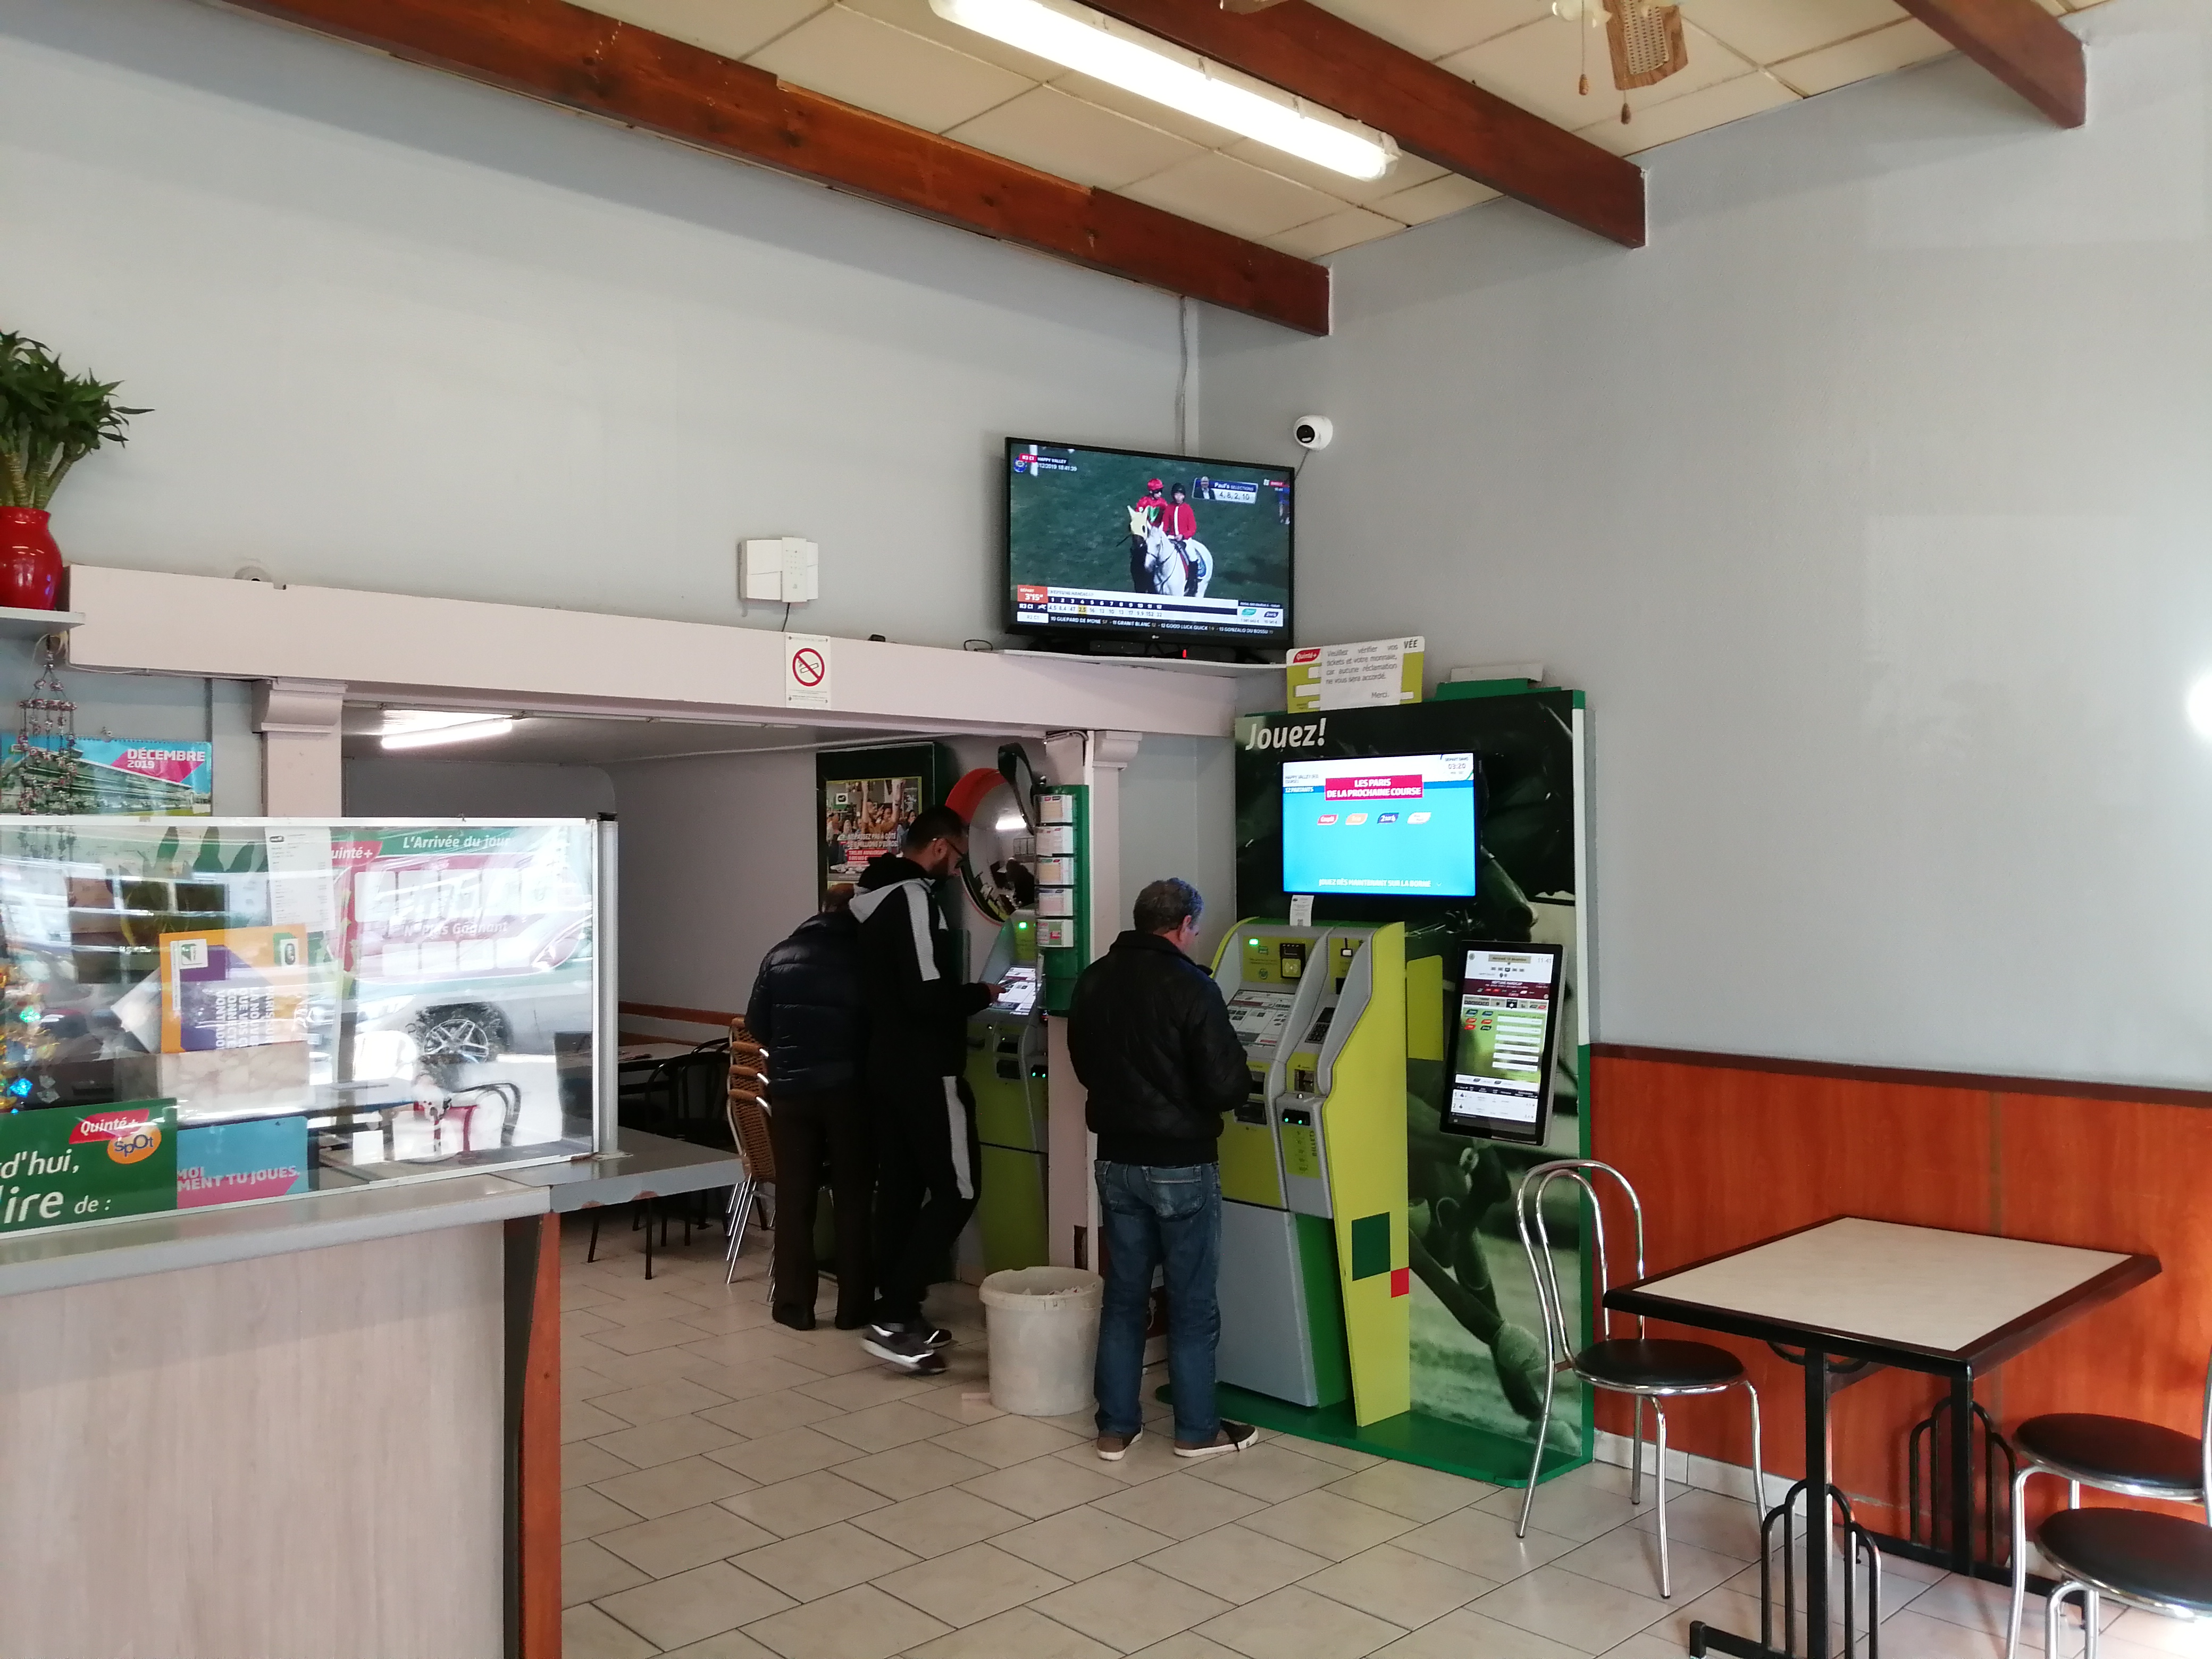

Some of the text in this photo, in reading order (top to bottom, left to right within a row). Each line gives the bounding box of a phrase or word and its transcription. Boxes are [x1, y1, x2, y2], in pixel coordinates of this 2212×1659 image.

[1327, 649, 1348, 657] Veuillez
[1327, 658, 1345, 666] tickets
[1245, 717, 1327, 751] Jouez!
[127, 747, 205, 763] DÉCEMBRE
[127, 759, 155, 769] 2019
[1354, 779, 1368, 787] LES
[1327, 790, 1337, 798] DE
[1347, 788, 1390, 797] PROCHAINE
[1390, 787, 1421, 796] COURSE
[403, 835, 511, 849] L'Arrivée du jour
[331, 847, 373, 859] uinté+
[455, 921, 507, 936] Gagnant
[81, 1117, 138, 1135] Quinté+
[0, 1148, 80, 1179] d'hui,
[225, 1173, 248, 1186] TU
[74, 1195, 99, 1214] de
